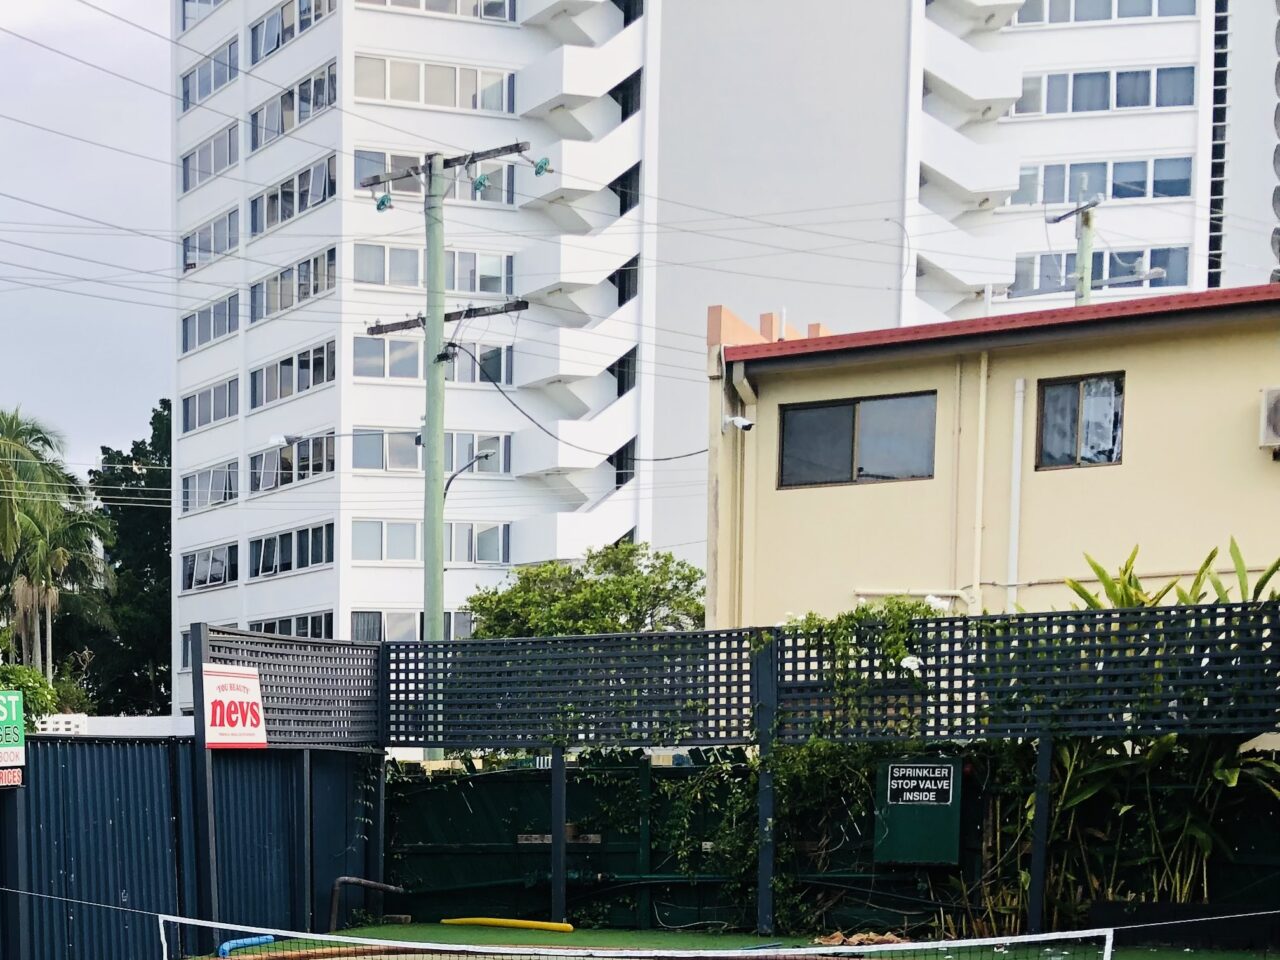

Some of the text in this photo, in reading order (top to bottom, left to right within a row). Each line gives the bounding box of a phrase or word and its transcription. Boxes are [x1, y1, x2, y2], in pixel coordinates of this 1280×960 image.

[210, 698, 261, 728] nevs
[893, 767, 949, 778] SPRINKLER
[890, 779, 950, 790] STOP VALVE
[903, 791, 936, 801] INSIDE
